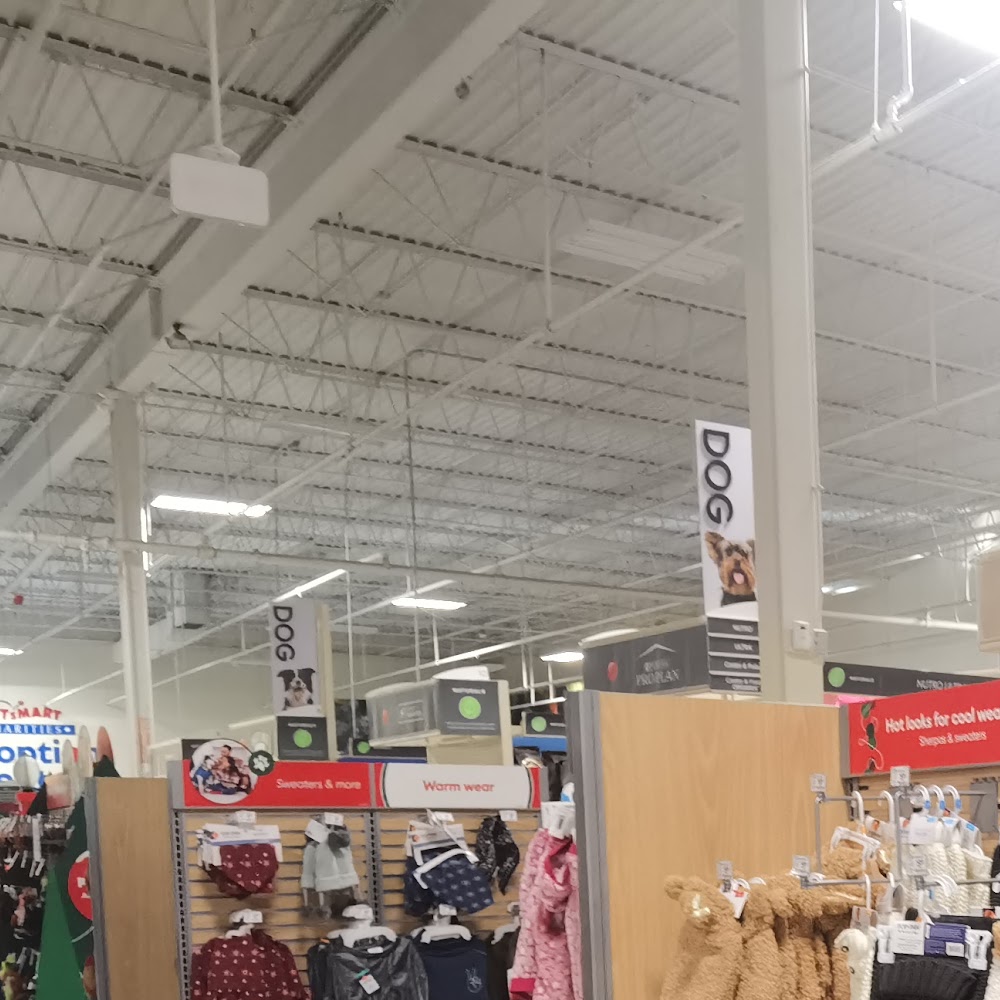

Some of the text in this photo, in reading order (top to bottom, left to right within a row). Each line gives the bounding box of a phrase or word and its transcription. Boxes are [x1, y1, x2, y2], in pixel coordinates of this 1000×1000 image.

[703, 429, 733, 524] DOG
[273, 606, 295, 662] DOG
[885, 718, 905, 733] Hot
[905, 713, 933, 732] looks
[933, 710, 949, 728] for
[951, 706, 976, 726] cool
[0, 724, 62, 734] ARITIES
[955, 731, 987, 743] sweaters
[276, 779, 362, 790] Sweaters & more
[423, 780, 495, 792] Warm wear
